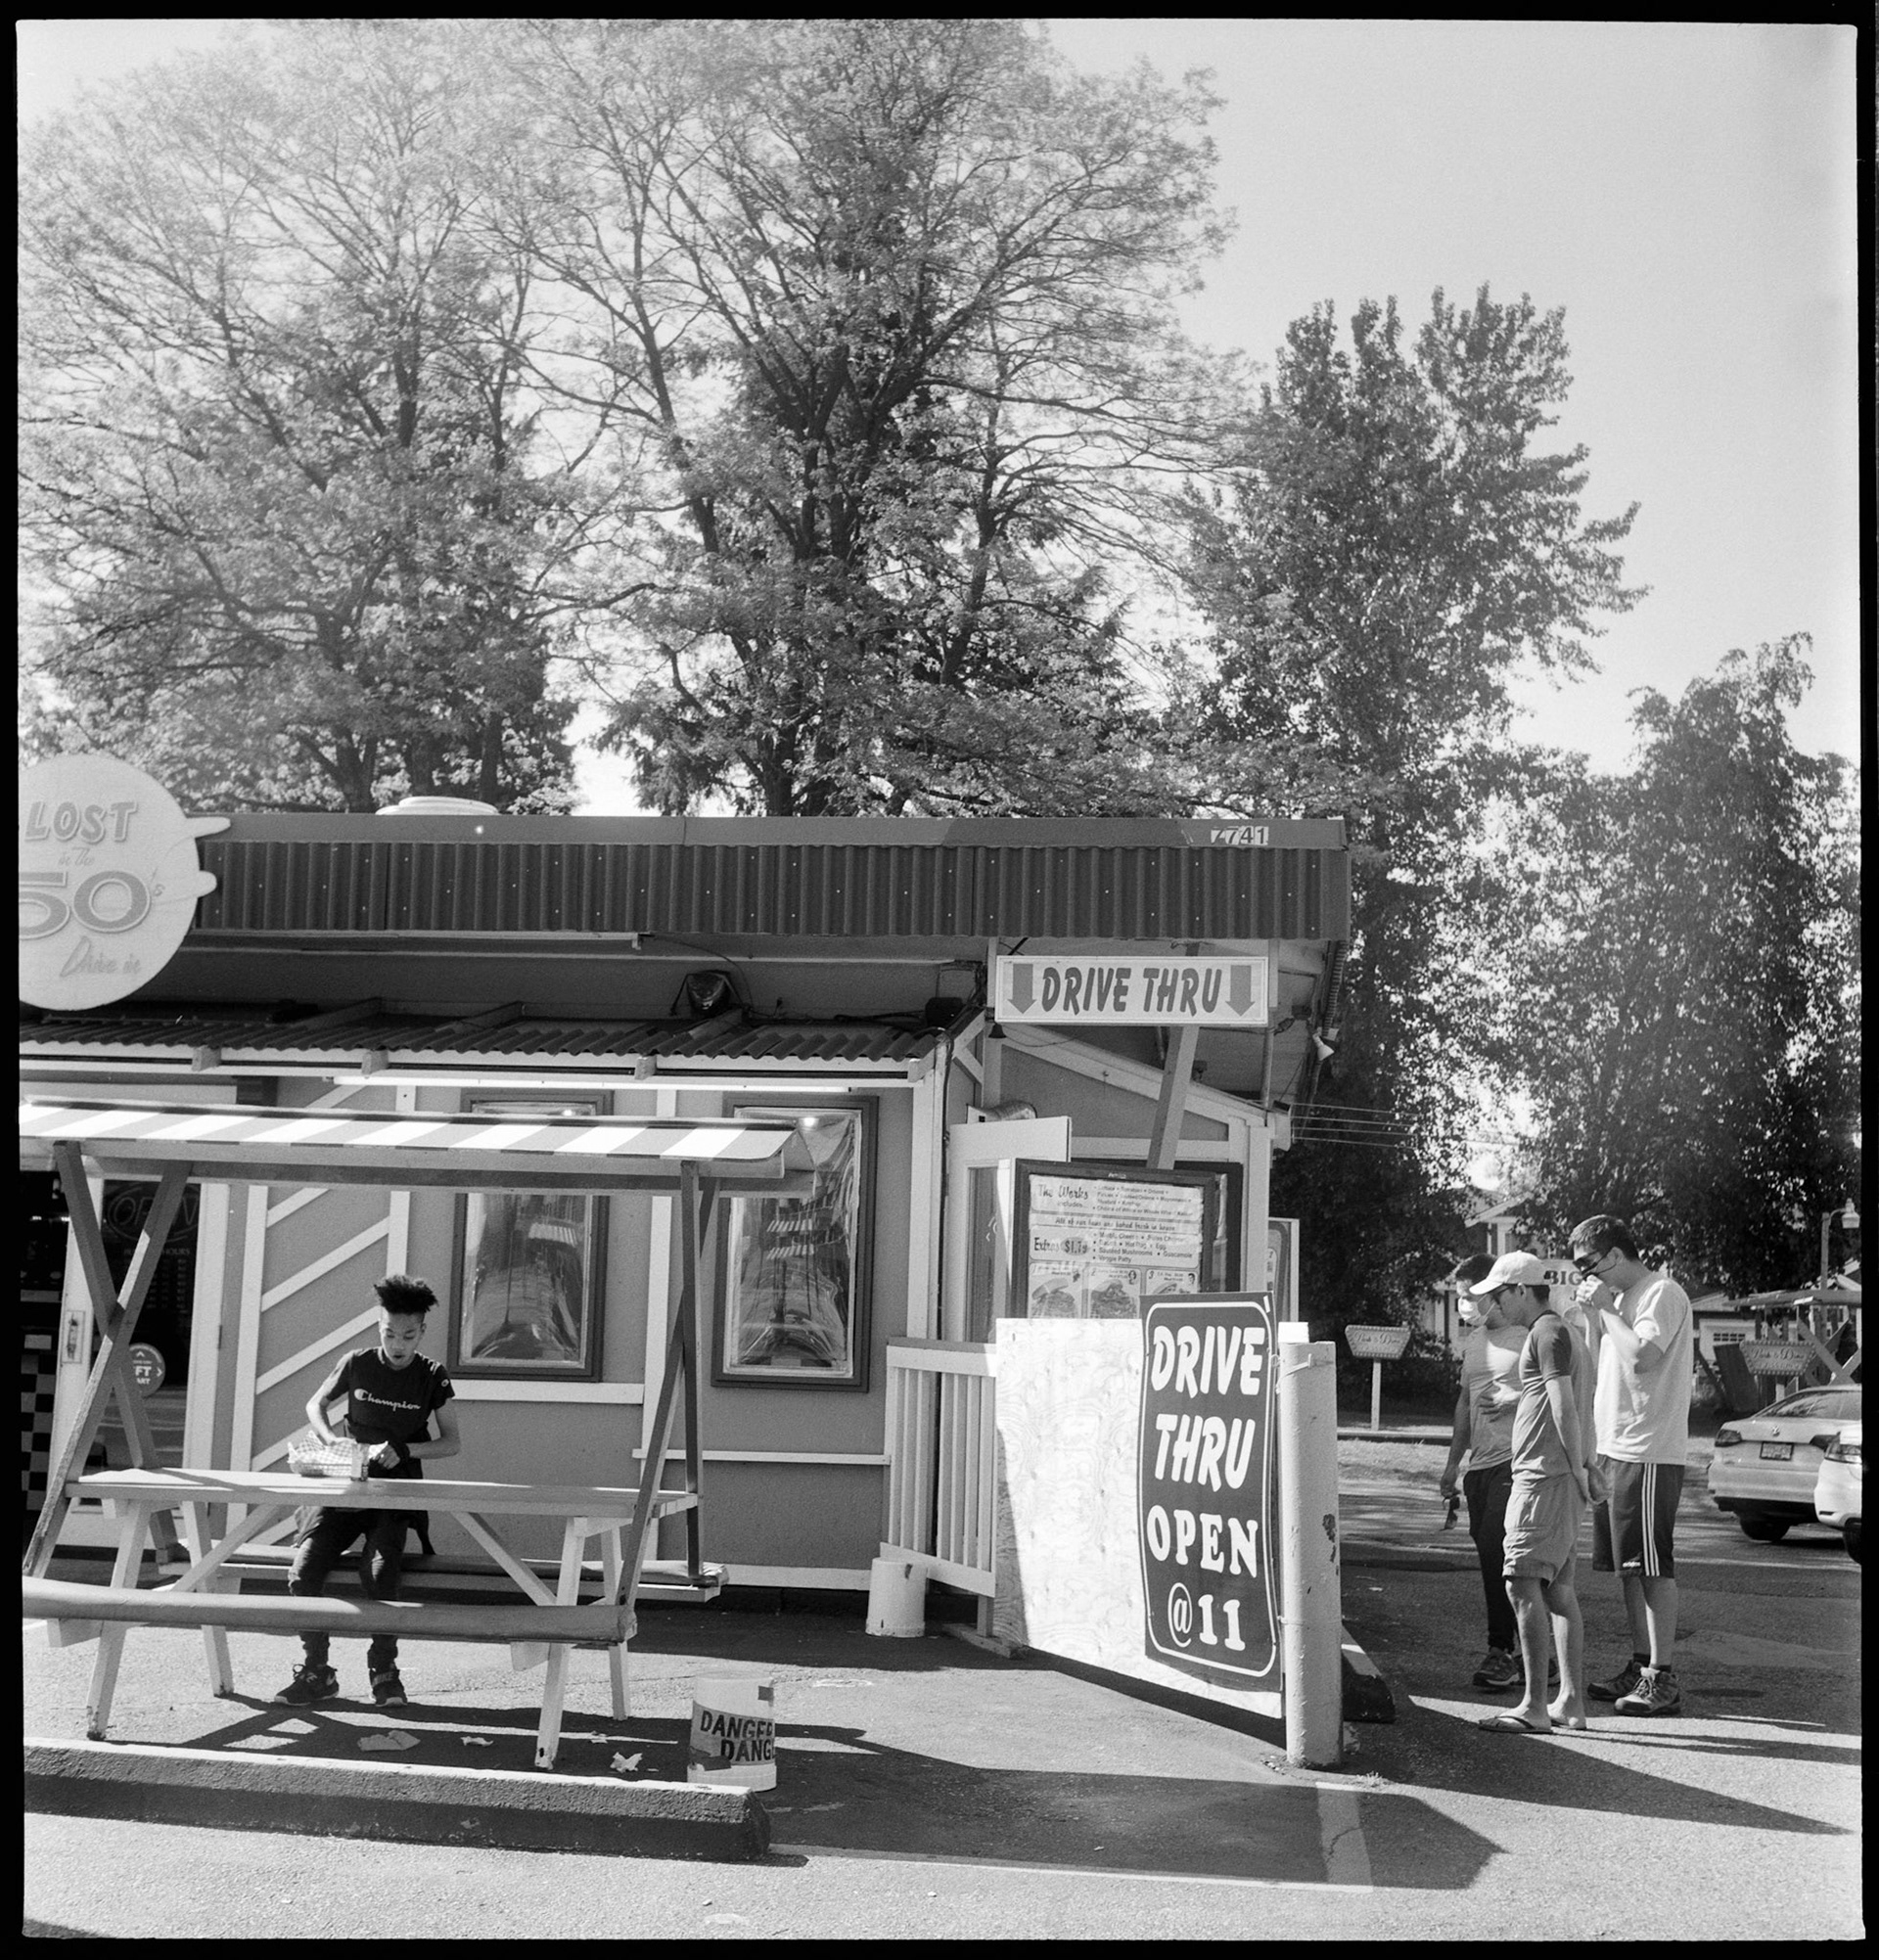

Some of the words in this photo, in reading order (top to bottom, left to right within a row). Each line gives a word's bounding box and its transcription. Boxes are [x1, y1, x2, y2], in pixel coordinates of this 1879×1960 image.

[24, 800, 139, 843] LOST
[1212, 827, 1266, 844] 7741
[1041, 967, 1131, 1016] DRIVE
[1143, 967, 1222, 1017] THRU
[1038, 1184, 1053, 1198] The
[1058, 1185, 1088, 1200] Works
[114, 1197, 199, 1226] OPN
[1034, 1237, 1060, 1253] Extras
[1545, 1270, 1582, 1286] BIG
[135, 1365, 153, 1377] FT
[1150, 1325, 1265, 1399] DRIVE
[354, 1388, 422, 1411] Champion
[1155, 1413, 1257, 1492] THRU
[1147, 1504, 1260, 1578] OPEN
[720, 1739, 774, 1762] DANG
